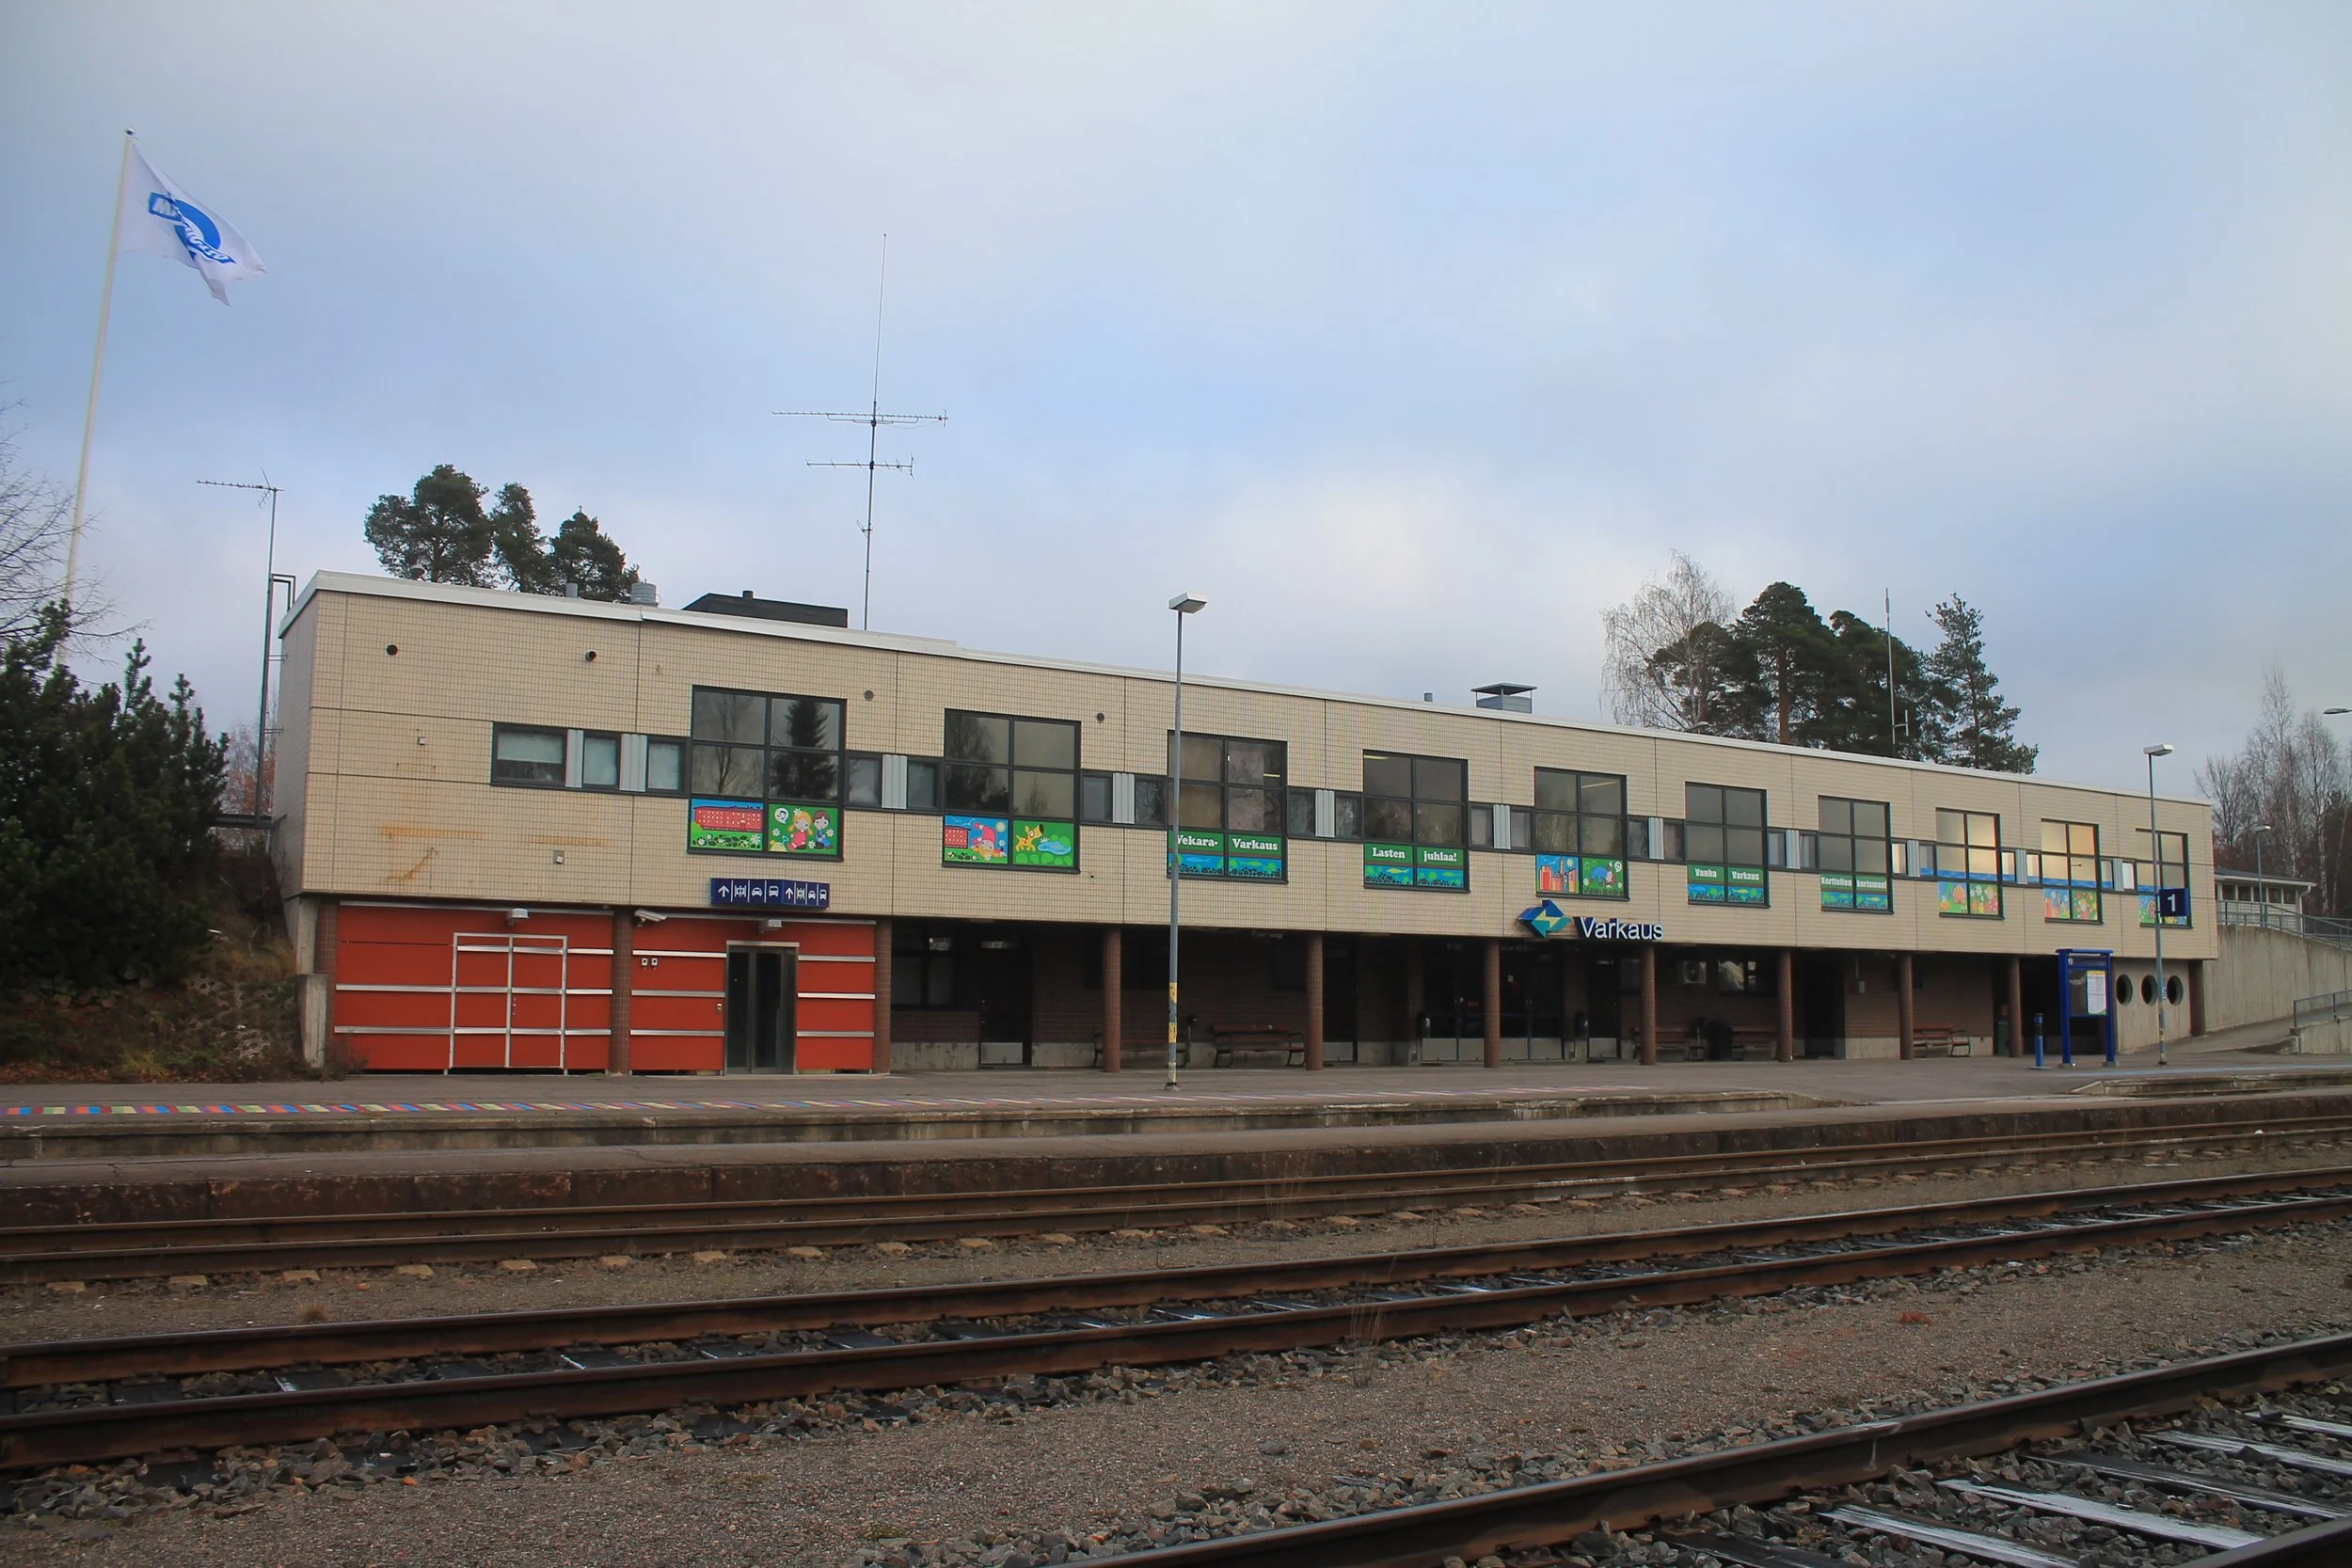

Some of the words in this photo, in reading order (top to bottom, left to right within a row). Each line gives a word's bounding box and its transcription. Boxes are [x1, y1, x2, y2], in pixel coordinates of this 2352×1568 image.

[1177, 834, 1219, 847] Vekara-
[1232, 838, 1279, 850] Varkaus
[1372, 847, 1406, 859] Lasten
[1423, 850, 1457, 863] juhlaa!
[1694, 867, 1717, 879] Vanha
[1731, 871, 1760, 881] Varkaus
[2167, 894, 2175, 912] 1
[1578, 916, 1664, 941] Varkaus
